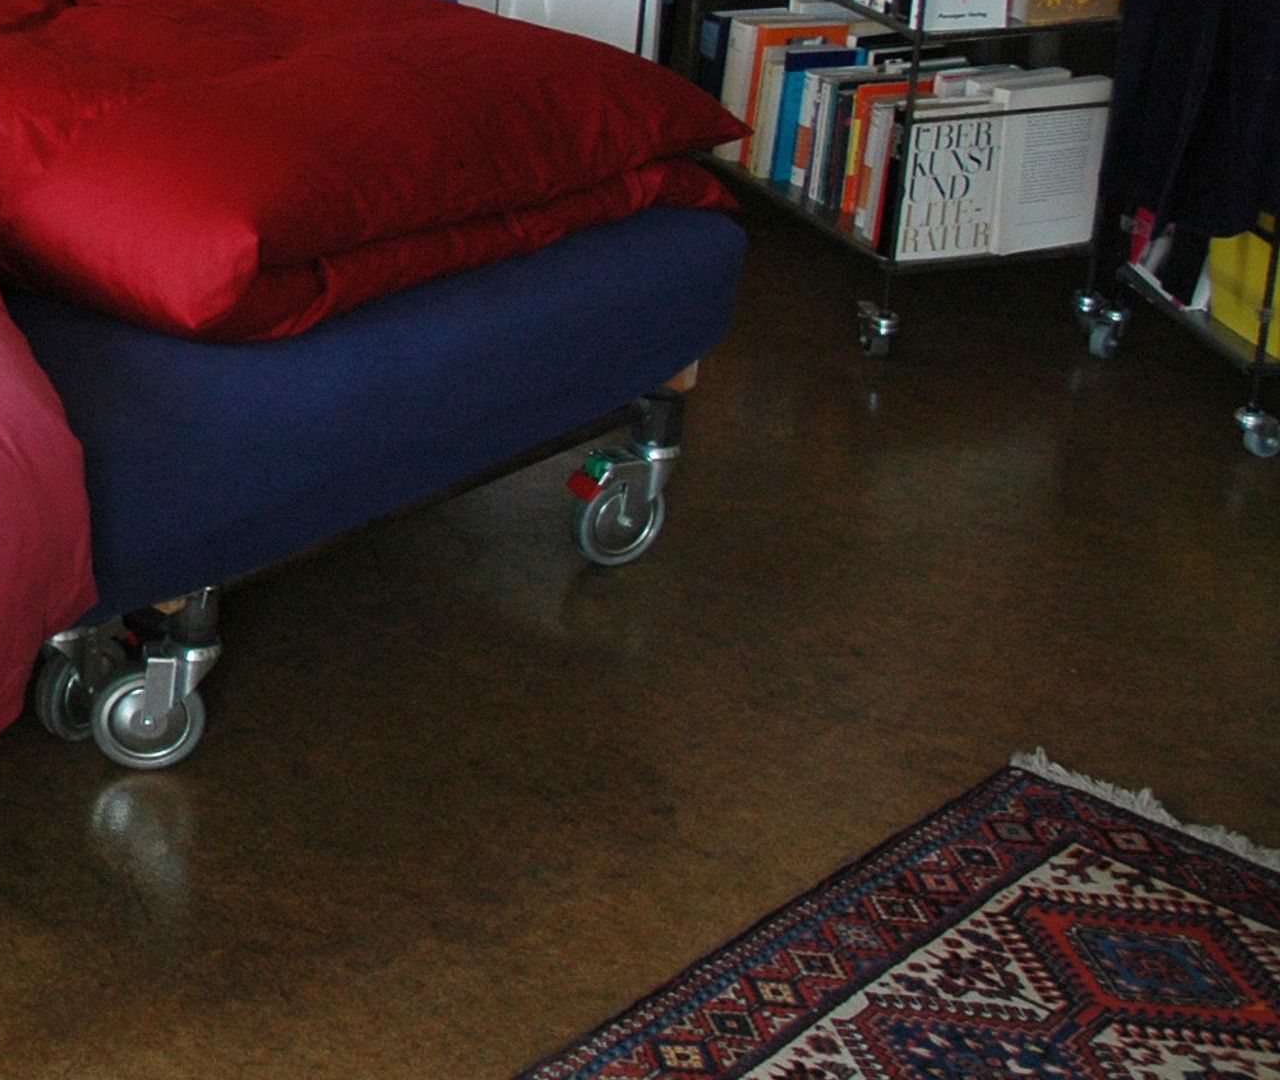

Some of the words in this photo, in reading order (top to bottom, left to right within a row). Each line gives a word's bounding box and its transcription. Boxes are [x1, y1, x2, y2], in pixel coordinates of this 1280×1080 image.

[912, 145, 1000, 177] KUNST
[909, 174, 971, 202] UND
[905, 199, 983, 227] LITE-
[901, 222, 990, 254] RATUR
